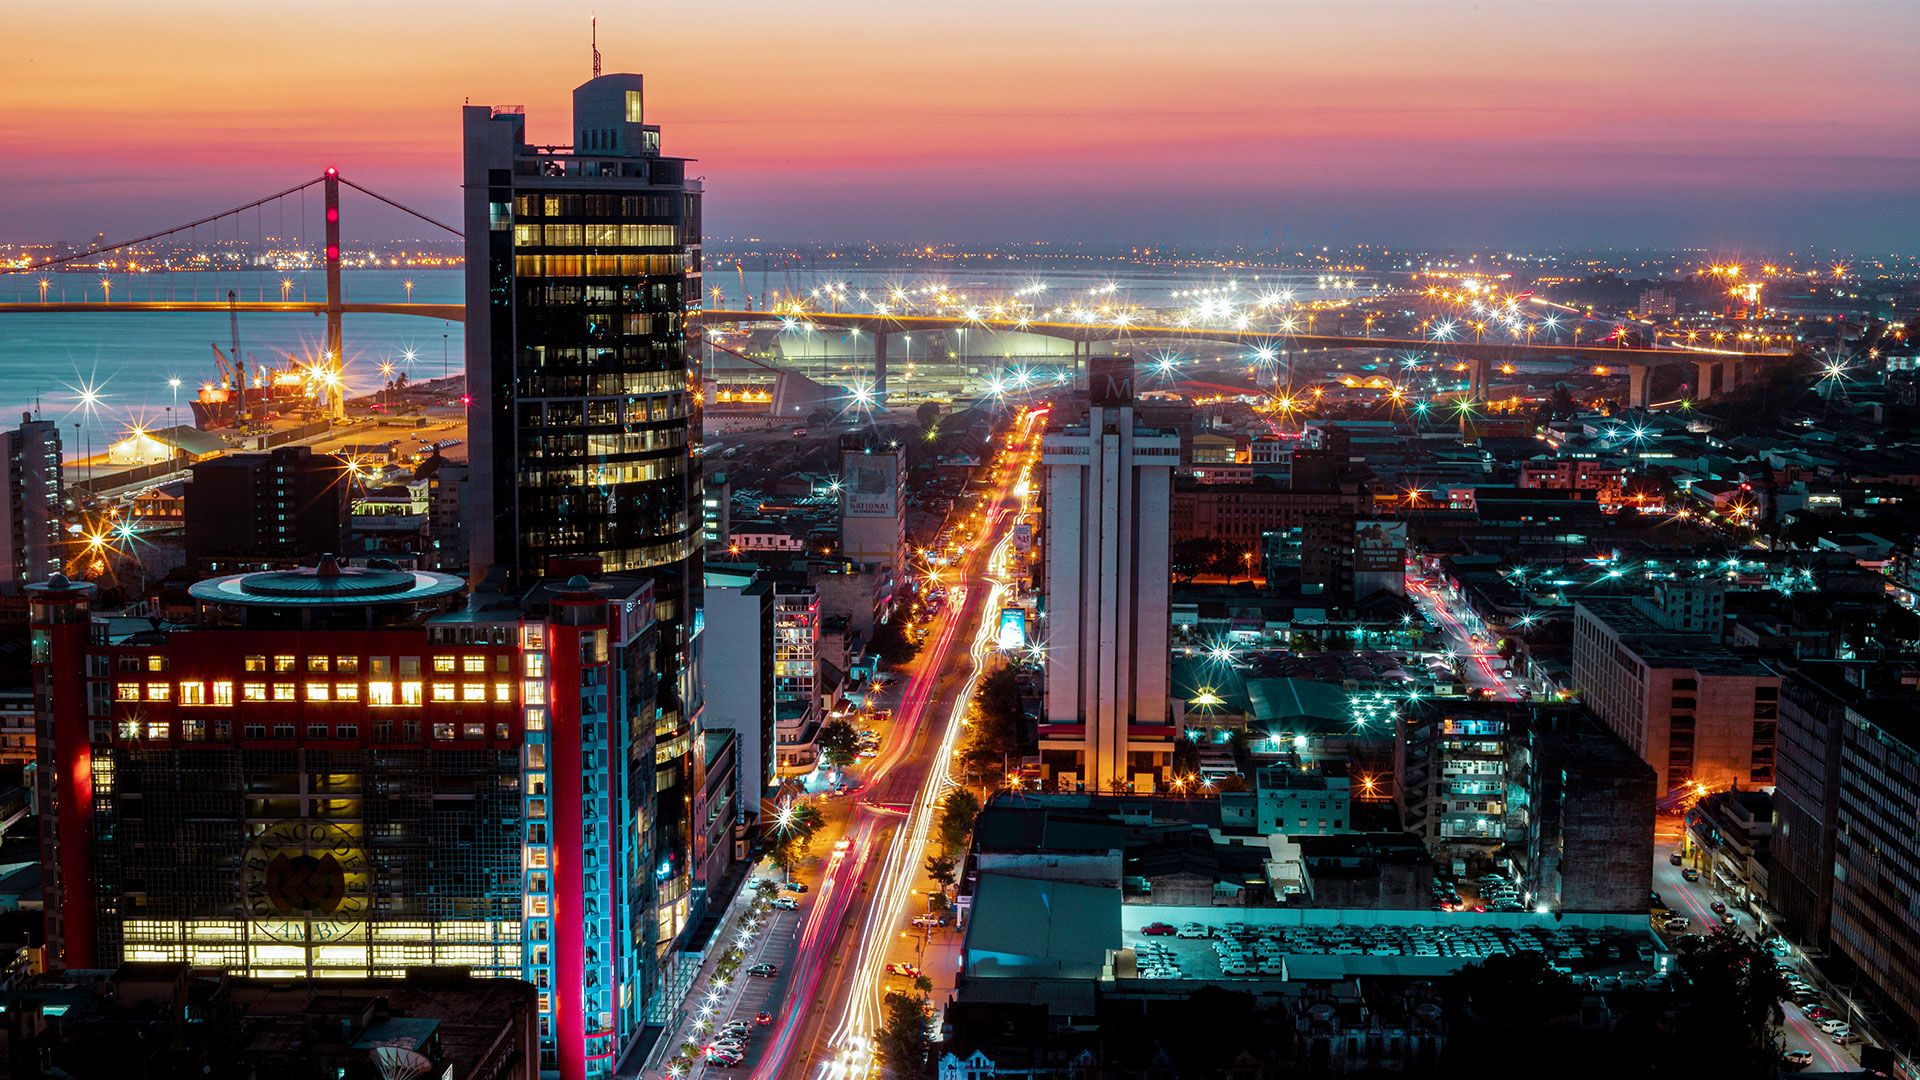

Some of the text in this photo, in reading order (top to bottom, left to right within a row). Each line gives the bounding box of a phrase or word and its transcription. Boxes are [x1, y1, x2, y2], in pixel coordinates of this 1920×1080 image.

[1105, 373, 1131, 400] M
[248, 824, 363, 872] BANCO DE
